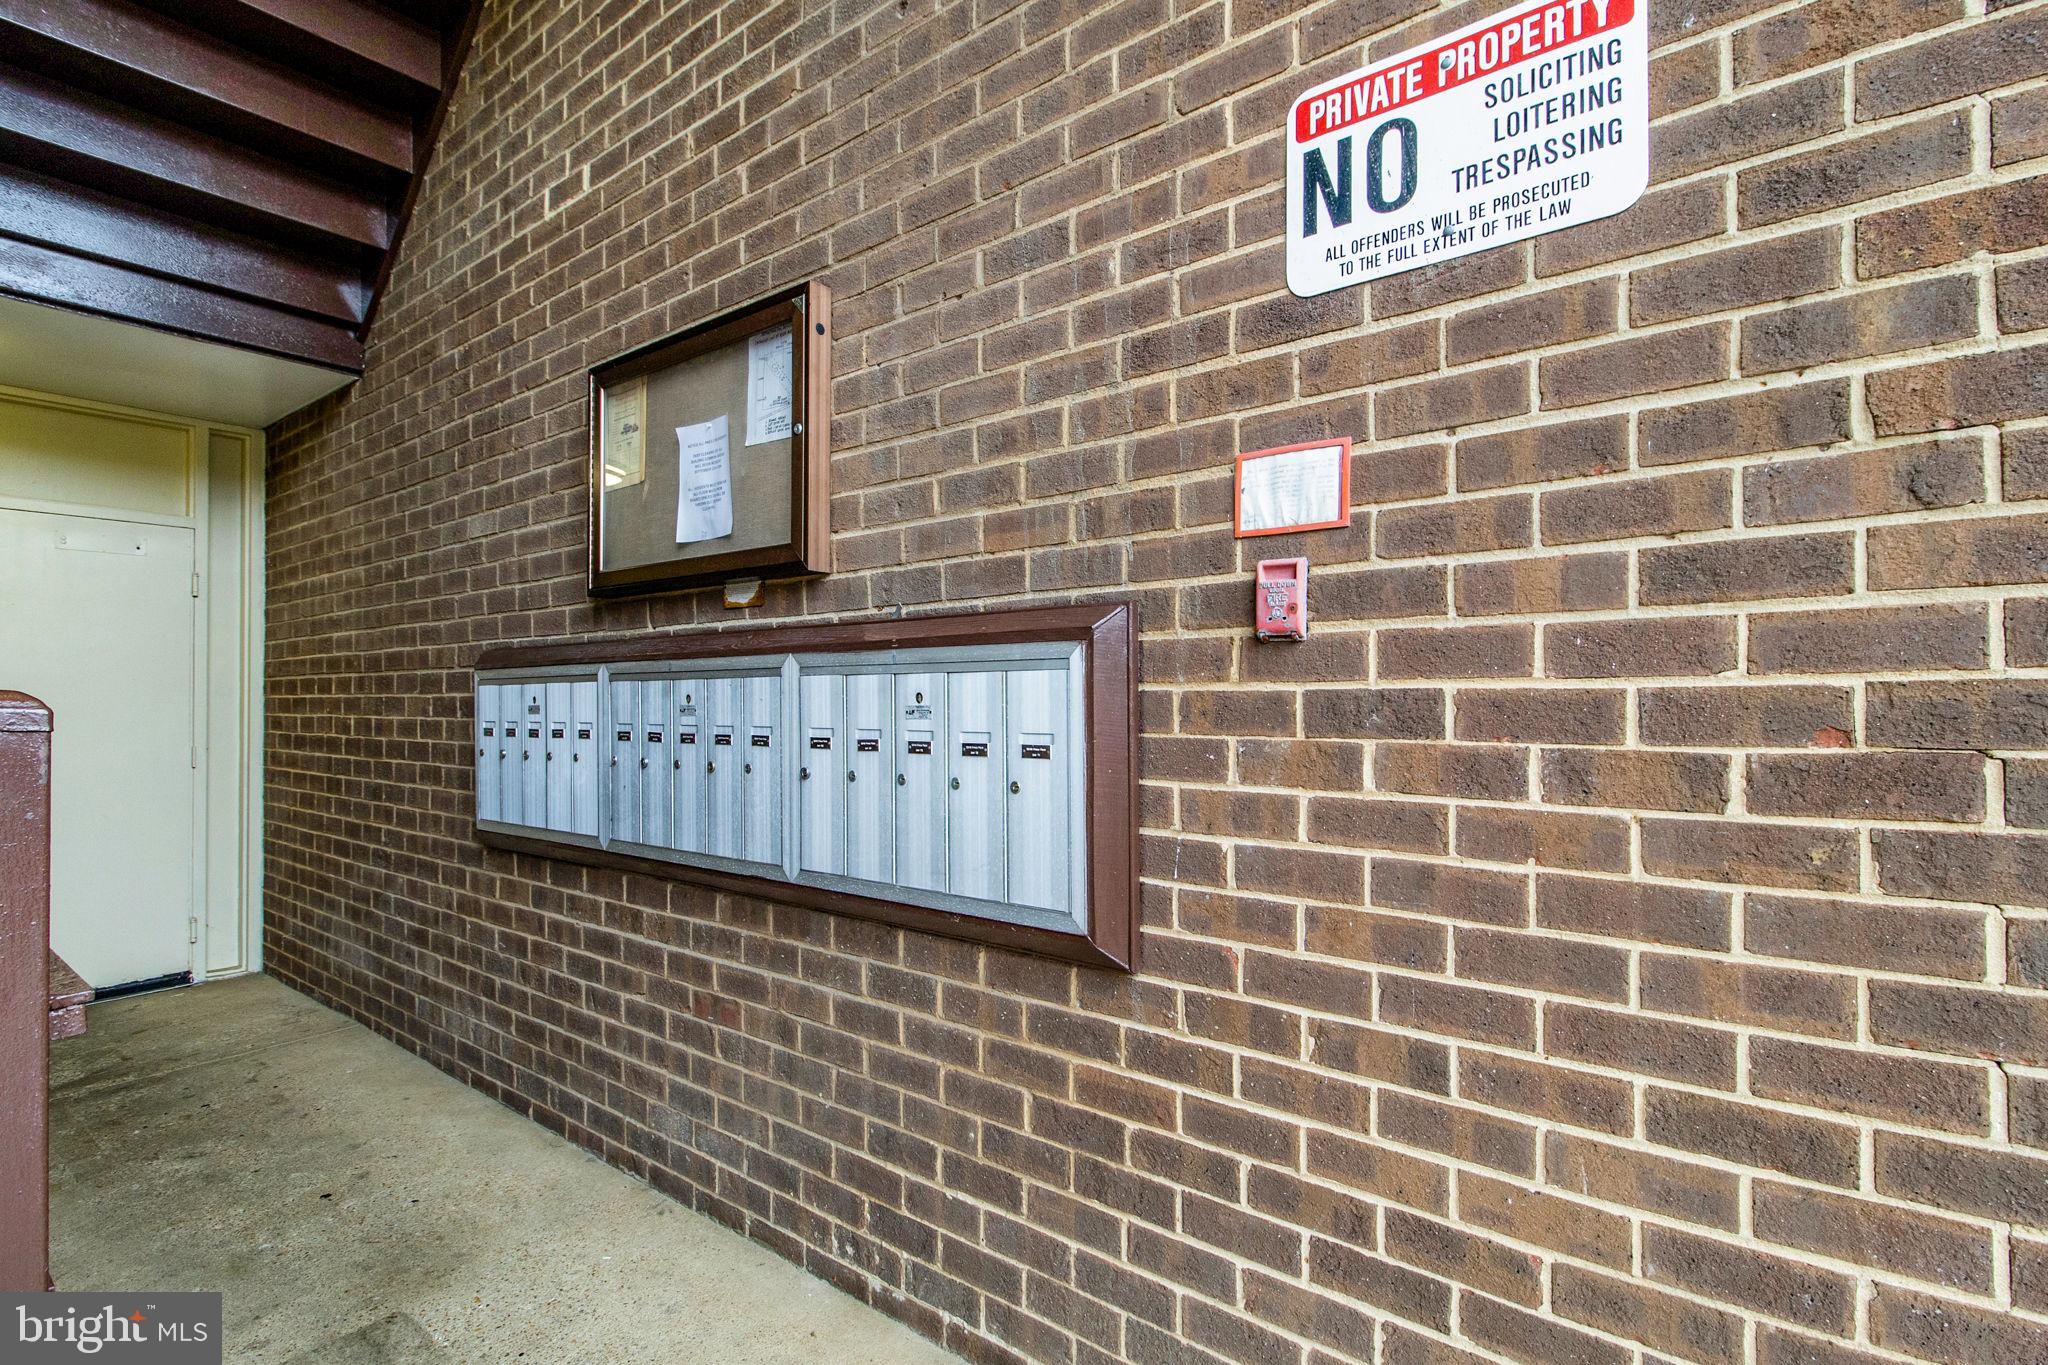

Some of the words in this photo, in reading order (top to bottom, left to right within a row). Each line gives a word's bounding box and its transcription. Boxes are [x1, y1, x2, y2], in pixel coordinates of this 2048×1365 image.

[1309, 59, 1423, 135] PRIVATE
[1437, 0, 1611, 89] PROPERTY
[1484, 38, 1622, 109] SOLICITING
[1493, 77, 1622, 143] LOITERING
[1302, 117, 1418, 239] NO
[1451, 118, 1623, 194] TRESPASSING
[1325, 244, 1347, 262] ALL
[1351, 221, 1425, 254] OFFENDERS
[1431, 211, 1463, 232] WILL
[1469, 202, 1486, 221] BE
[1493, 171, 1591, 214] PROSECUTED
[1339, 260, 1354, 277] TO
[1359, 253, 1382, 271] THE
[1387, 245, 1418, 264] FULL
[1423, 226, 1476, 254] EXTENT
[1481, 220, 1499, 238] OF
[1505, 210, 1532, 232] THE
[1539, 199, 1572, 222] LAW
